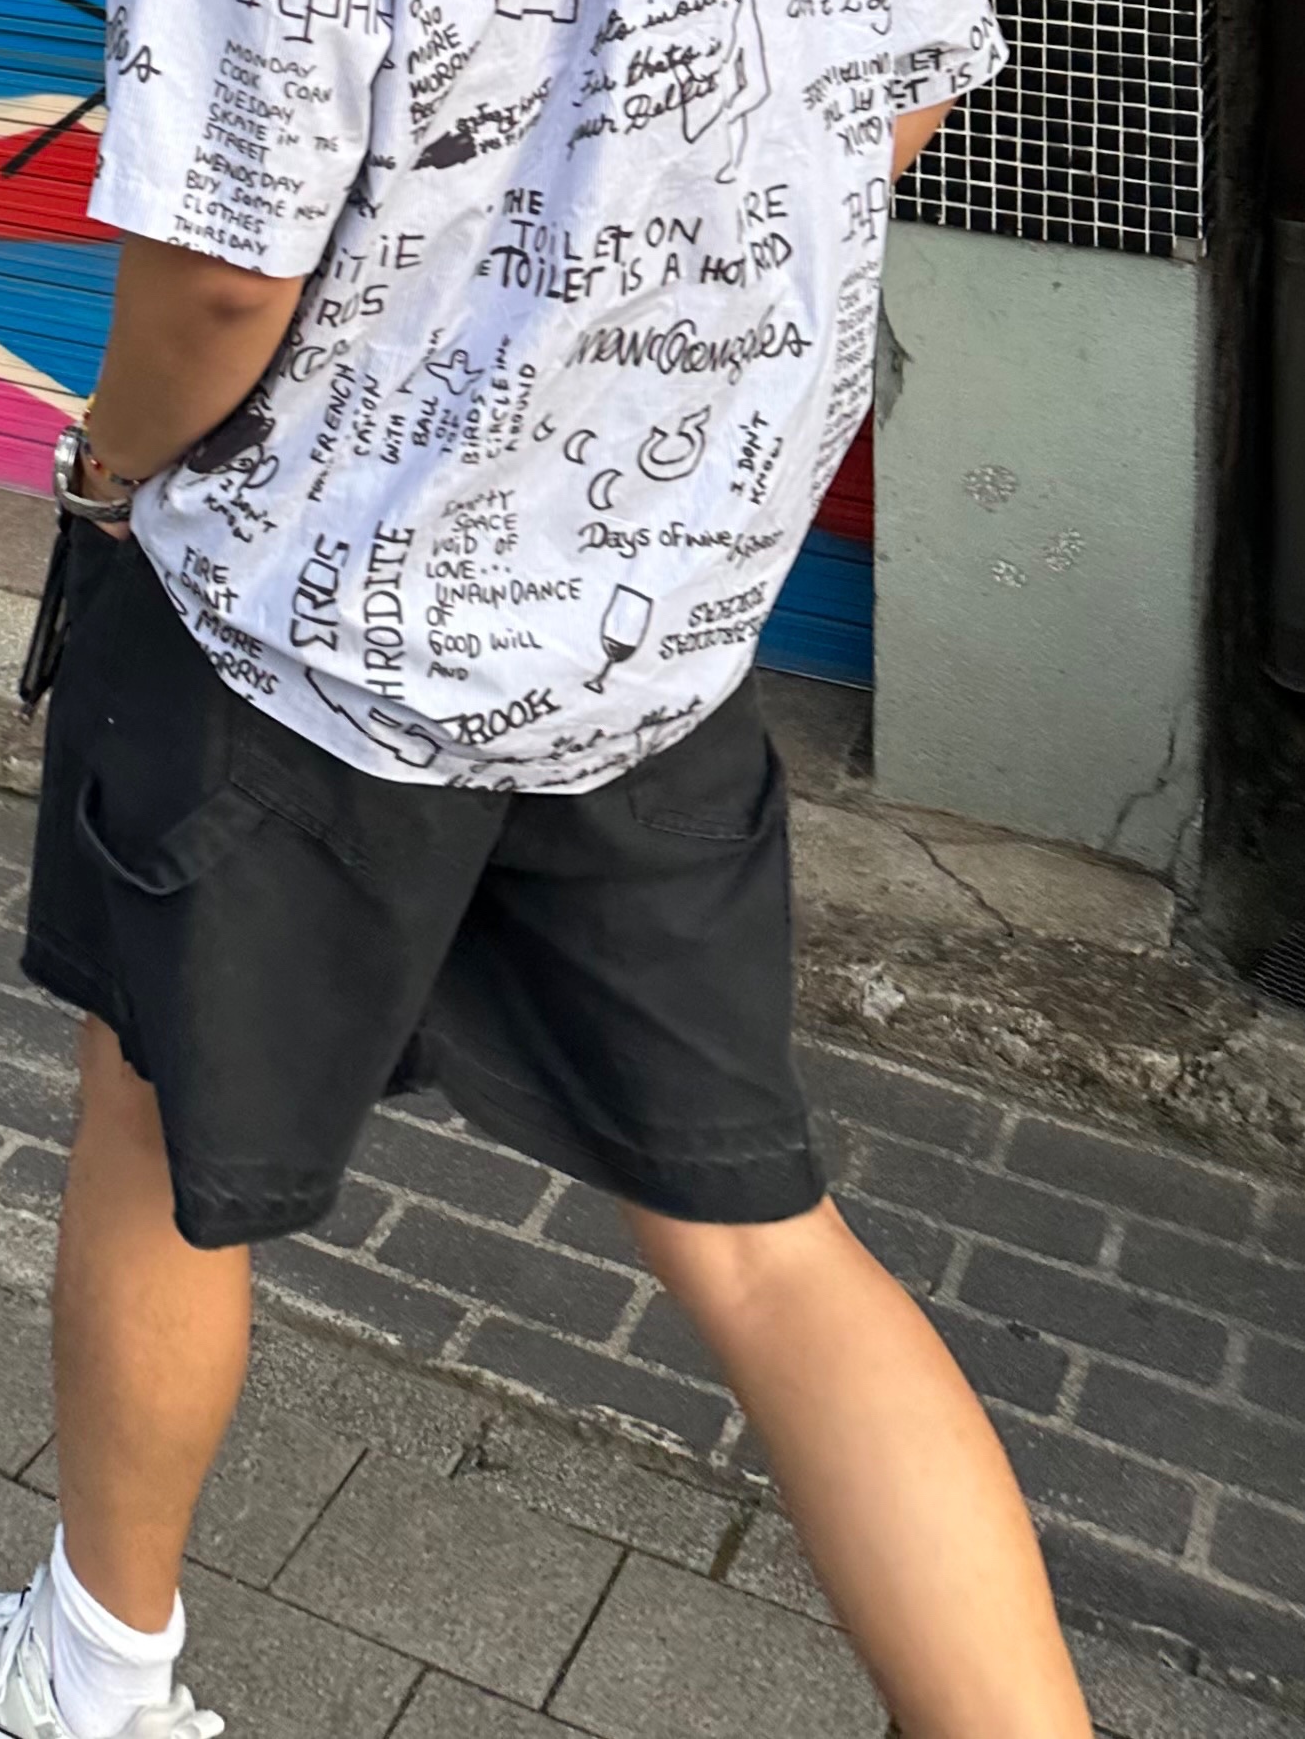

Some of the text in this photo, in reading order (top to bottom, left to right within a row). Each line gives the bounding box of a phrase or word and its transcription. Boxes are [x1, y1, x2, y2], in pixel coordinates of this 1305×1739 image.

[223, 38, 318, 79] MONDAY
[212, 78, 296, 125] TUESDAY
[207, 102, 269, 142] SKATE
[202, 122, 271, 165] STREET
[645, 216, 703, 249] ON
[660, 251, 682, 287] A
[427, 629, 481, 659] GOOD
